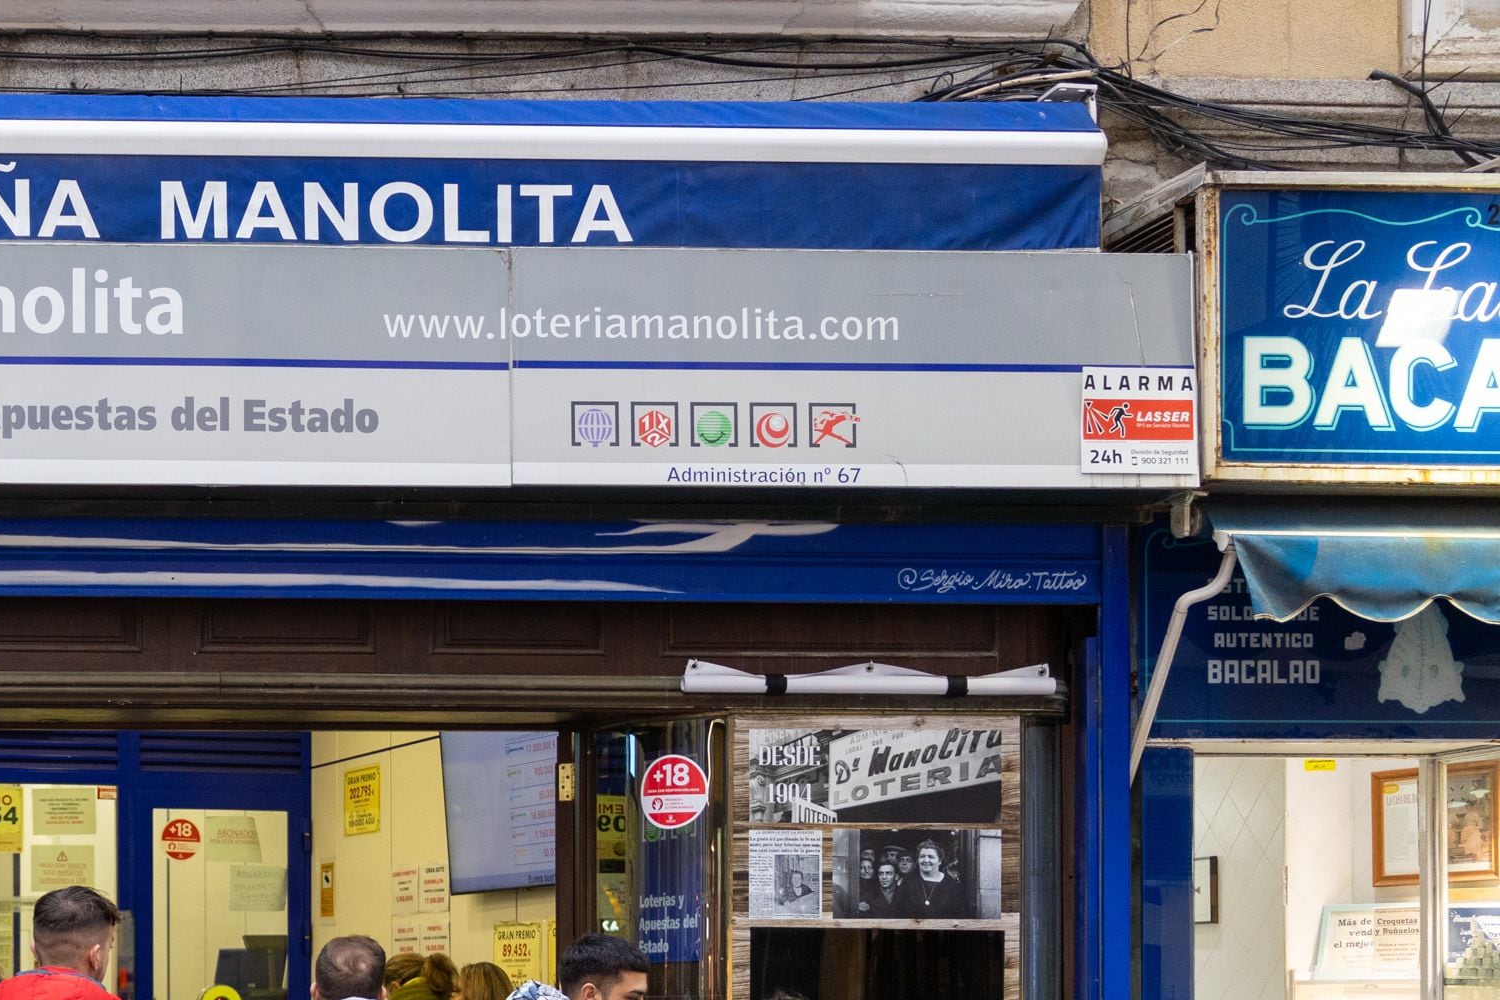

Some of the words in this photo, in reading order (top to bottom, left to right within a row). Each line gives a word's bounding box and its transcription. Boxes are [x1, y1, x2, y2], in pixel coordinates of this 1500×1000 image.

[160, 180, 634, 244] MANOLITA
[1283, 240, 1382, 322] La
[383, 306, 900, 342] www.loteriamanolita.com
[1084, 375, 1193, 391] ALARMA
[170, 396, 230, 432] del
[243, 398, 379, 435] Estado
[1136, 411, 1190, 422] LASSER
[1090, 449, 1123, 464] 24h
[667, 466, 806, 484] Administración
[838, 467, 861, 483] 67
[1213, 632, 1314, 649] AUTENTICO
[1207, 659, 1321, 684] BACALAO
[758, 745, 821, 766] DESDE
[653, 763, 690, 786] +18
[833, 754, 1002, 806] LOTERIA
[766, 782, 813, 804] 1904
[169, 822, 193, 837] +18
[638, 892, 676, 909] Loterías
[678, 894, 685, 909] y
[638, 916, 681, 936] Apuestas
[683, 914, 699, 930] del
[1337, 917, 1357, 927] Más
[1360, 917, 1372, 926] de
[1376, 917, 1418, 927] Croquetas
[497, 930, 514, 941] GRAN
[515, 929, 536, 940] PREMIO
[1349, 927, 1373, 937] vend
[1382, 927, 1420, 936] Buñuelos
[638, 938, 670, 954] Estado
[1333, 940, 1343, 949] el
